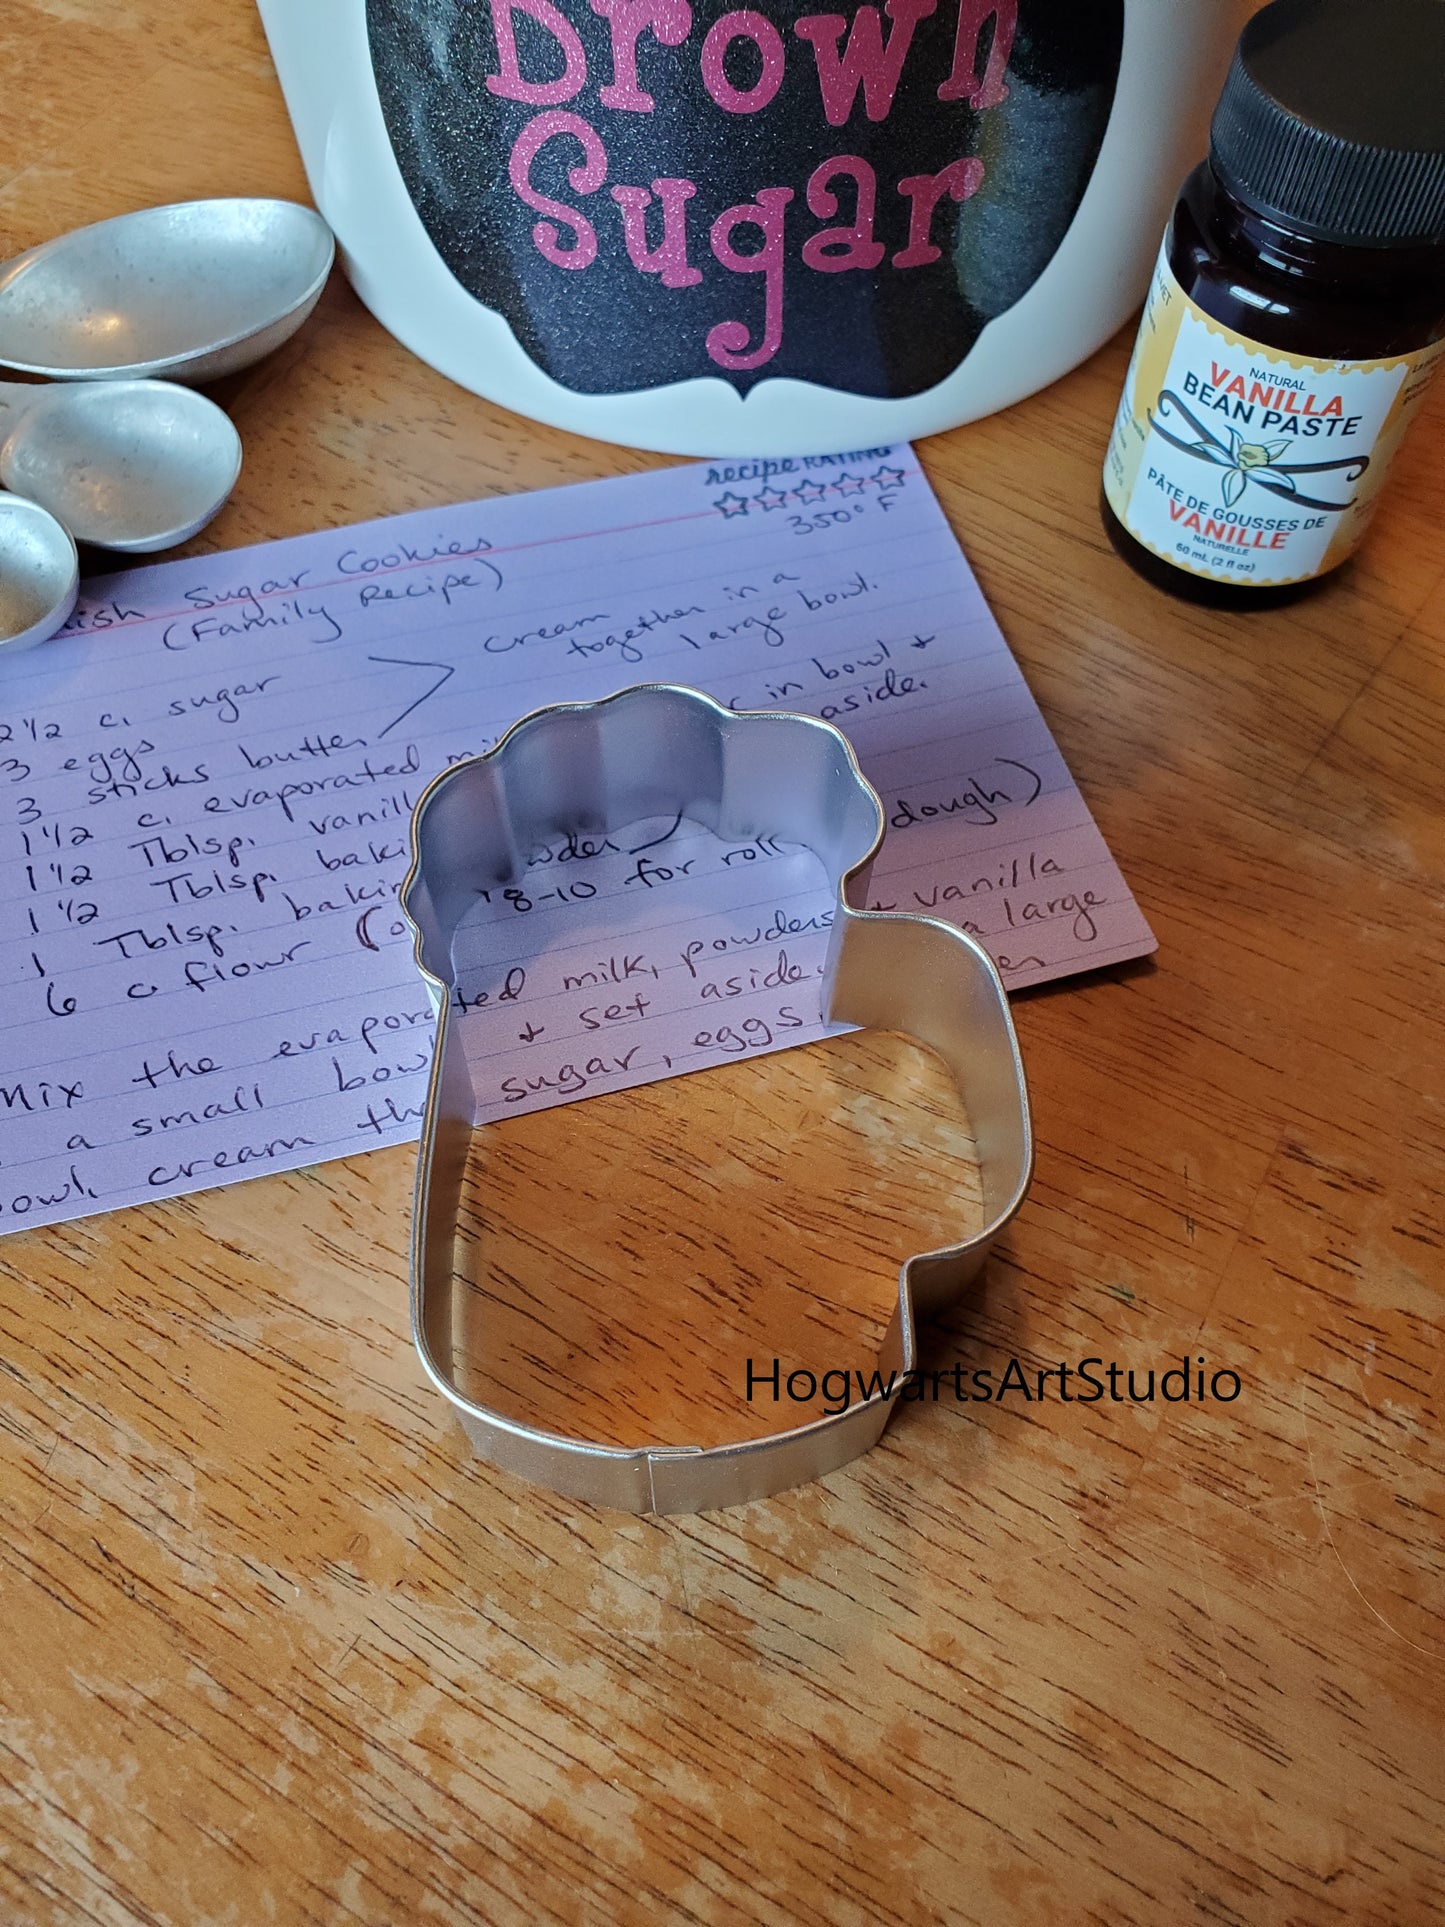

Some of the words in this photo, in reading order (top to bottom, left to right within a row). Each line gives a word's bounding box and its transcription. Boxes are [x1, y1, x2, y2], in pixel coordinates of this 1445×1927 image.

[508, 110, 985, 370] Sugar
[1183, 371, 1255, 424] BEAN
[1261, 411, 1362, 437] PASTE
[1211, 360, 1343, 417] VANILLA
[1250, 367, 1306, 391] NATURAL
[705, 458, 800, 486] recipe
[1147, 467, 1184, 503] PÂTE
[1187, 495, 1210, 515] DE
[1213, 507, 1299, 532] GOUSSES
[1303, 516, 1328, 530] DE
[1169, 499, 1291, 549] VANILLE
[1175, 542, 1190, 555] 60
[1193, 534, 1250, 556] NATURELLE
[185, 570, 311, 620] Sugar
[338, 535, 493, 576] Cookies
[566, 604, 706, 663] together
[723, 583, 760, 602] in
[772, 570, 800, 585] a
[680, 606, 787, 648] large
[765, 682, 803, 700] in
[812, 639, 890, 680] bowl
[168, 676, 281, 723] sugar
[0, 760, 31, 782] 3
[64, 740, 156, 783] eggs
[204, 745, 420, 822] evaporated
[17, 798, 42, 823] 3
[88, 762, 210, 806] sticks
[309, 791, 413, 835] vanill
[316, 838, 406, 871] baki
[282, 880, 401, 922] bakin
[46, 982, 77, 1017] 6
[185, 941, 312, 992] flour
[624, 857, 697, 889] for
[132, 1050, 224, 1089] the
[913, 851, 1065, 908] vanilla
[67, 1134, 97, 1150] a
[132, 1084, 265, 1137] small
[578, 991, 651, 1030] set
[1003, 890, 1108, 943] large
[148, 1136, 317, 1186] cream
